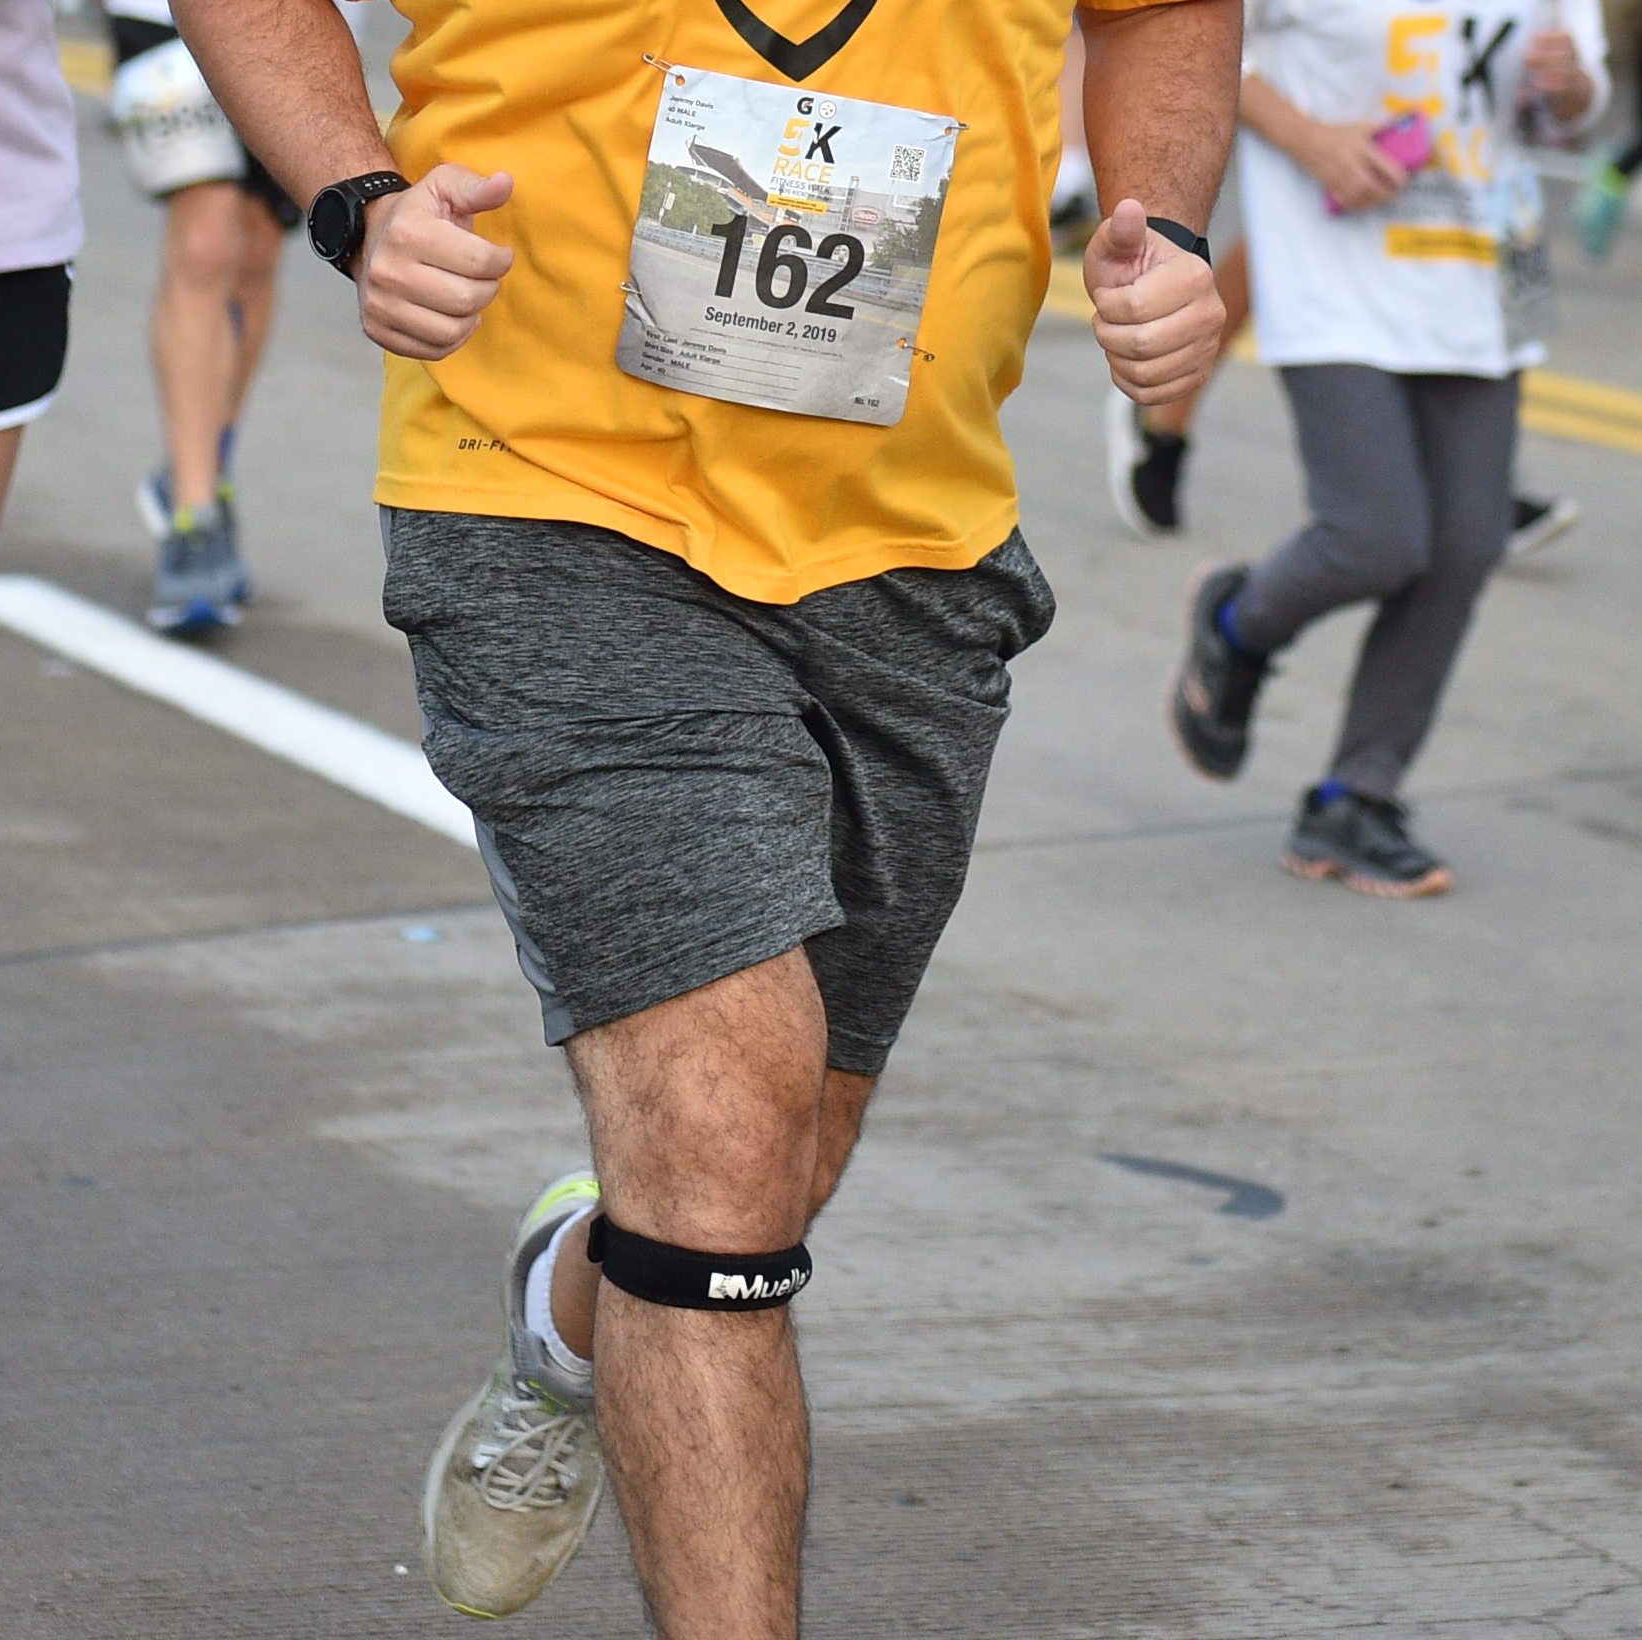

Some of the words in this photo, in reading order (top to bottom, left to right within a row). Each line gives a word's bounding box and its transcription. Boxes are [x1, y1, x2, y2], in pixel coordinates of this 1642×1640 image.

[777, 117, 843, 164] 5K
[773, 156, 835, 185] RACE
[709, 214, 866, 320] 162
[704, 306, 784, 334] September
[785, 321, 798, 339] 2,
[802, 324, 837, 343] 2019
[682, 340, 707, 351] Jeremy
[708, 344, 727, 354] Davis
[671, 360, 691, 370] MALE
[726, 1267, 810, 1300] Muelle
